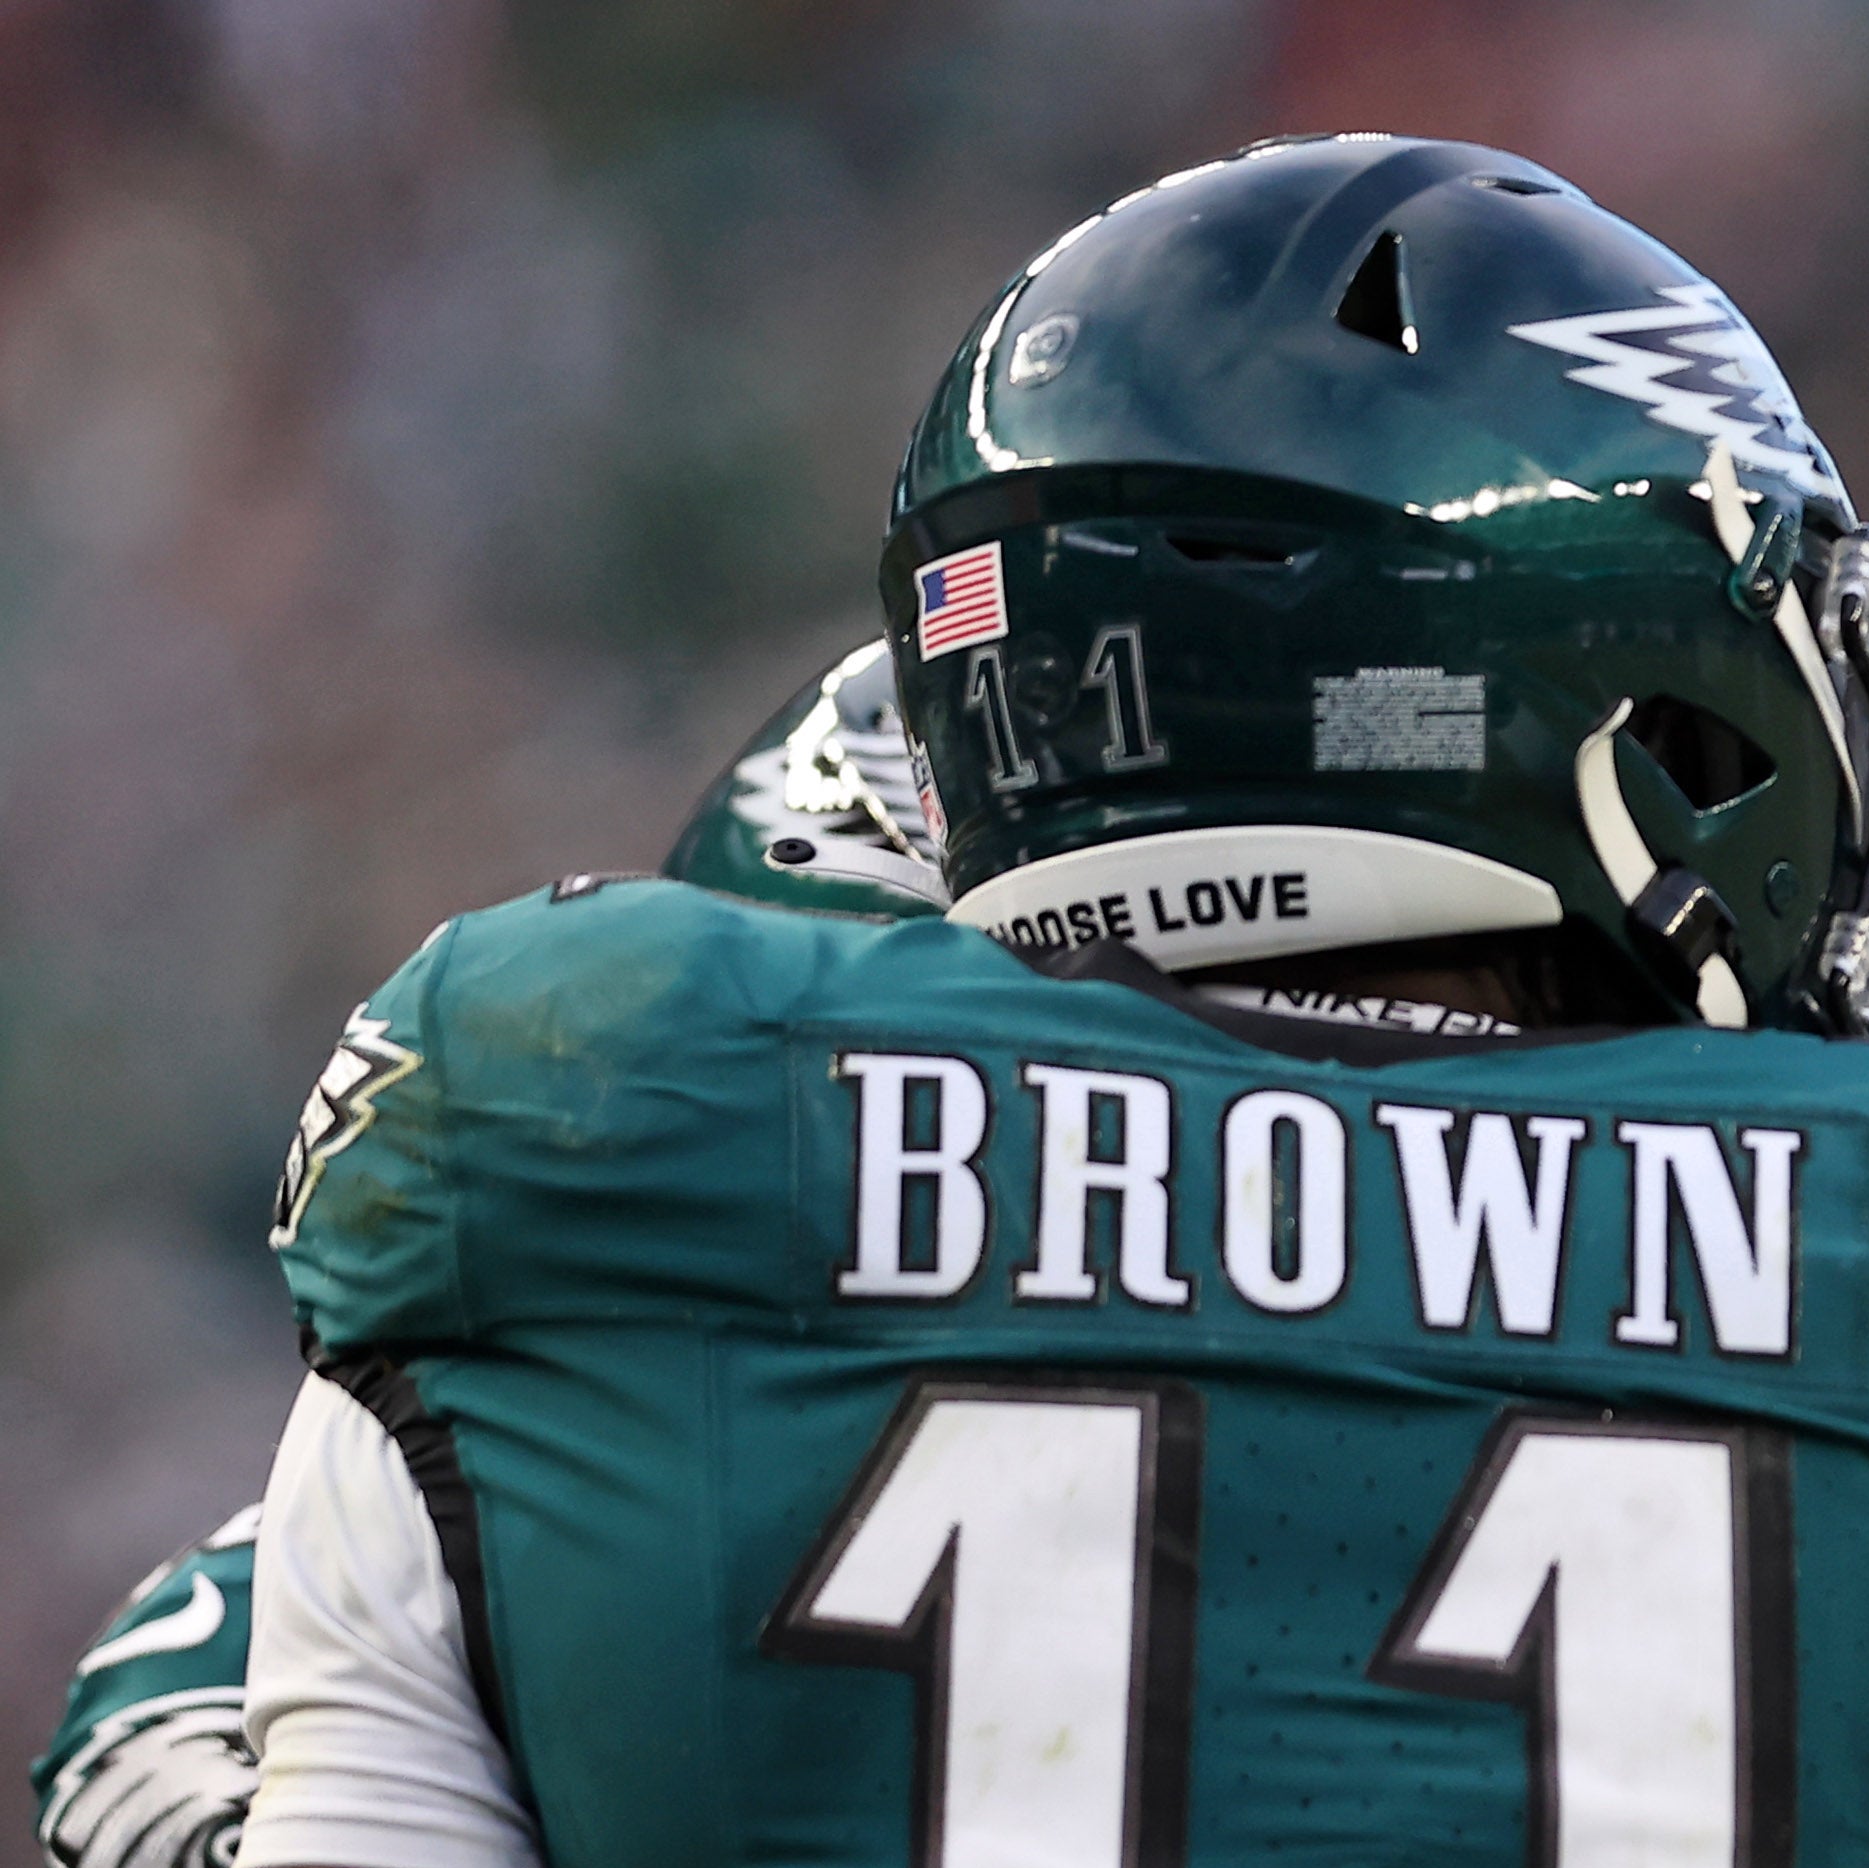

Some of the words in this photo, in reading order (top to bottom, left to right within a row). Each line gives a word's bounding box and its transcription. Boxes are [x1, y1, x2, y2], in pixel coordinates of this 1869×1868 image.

[963, 623, 1170, 793] 11
[1149, 873, 1310, 934] LOVE
[835, 1050, 1802, 1357] BROWN
